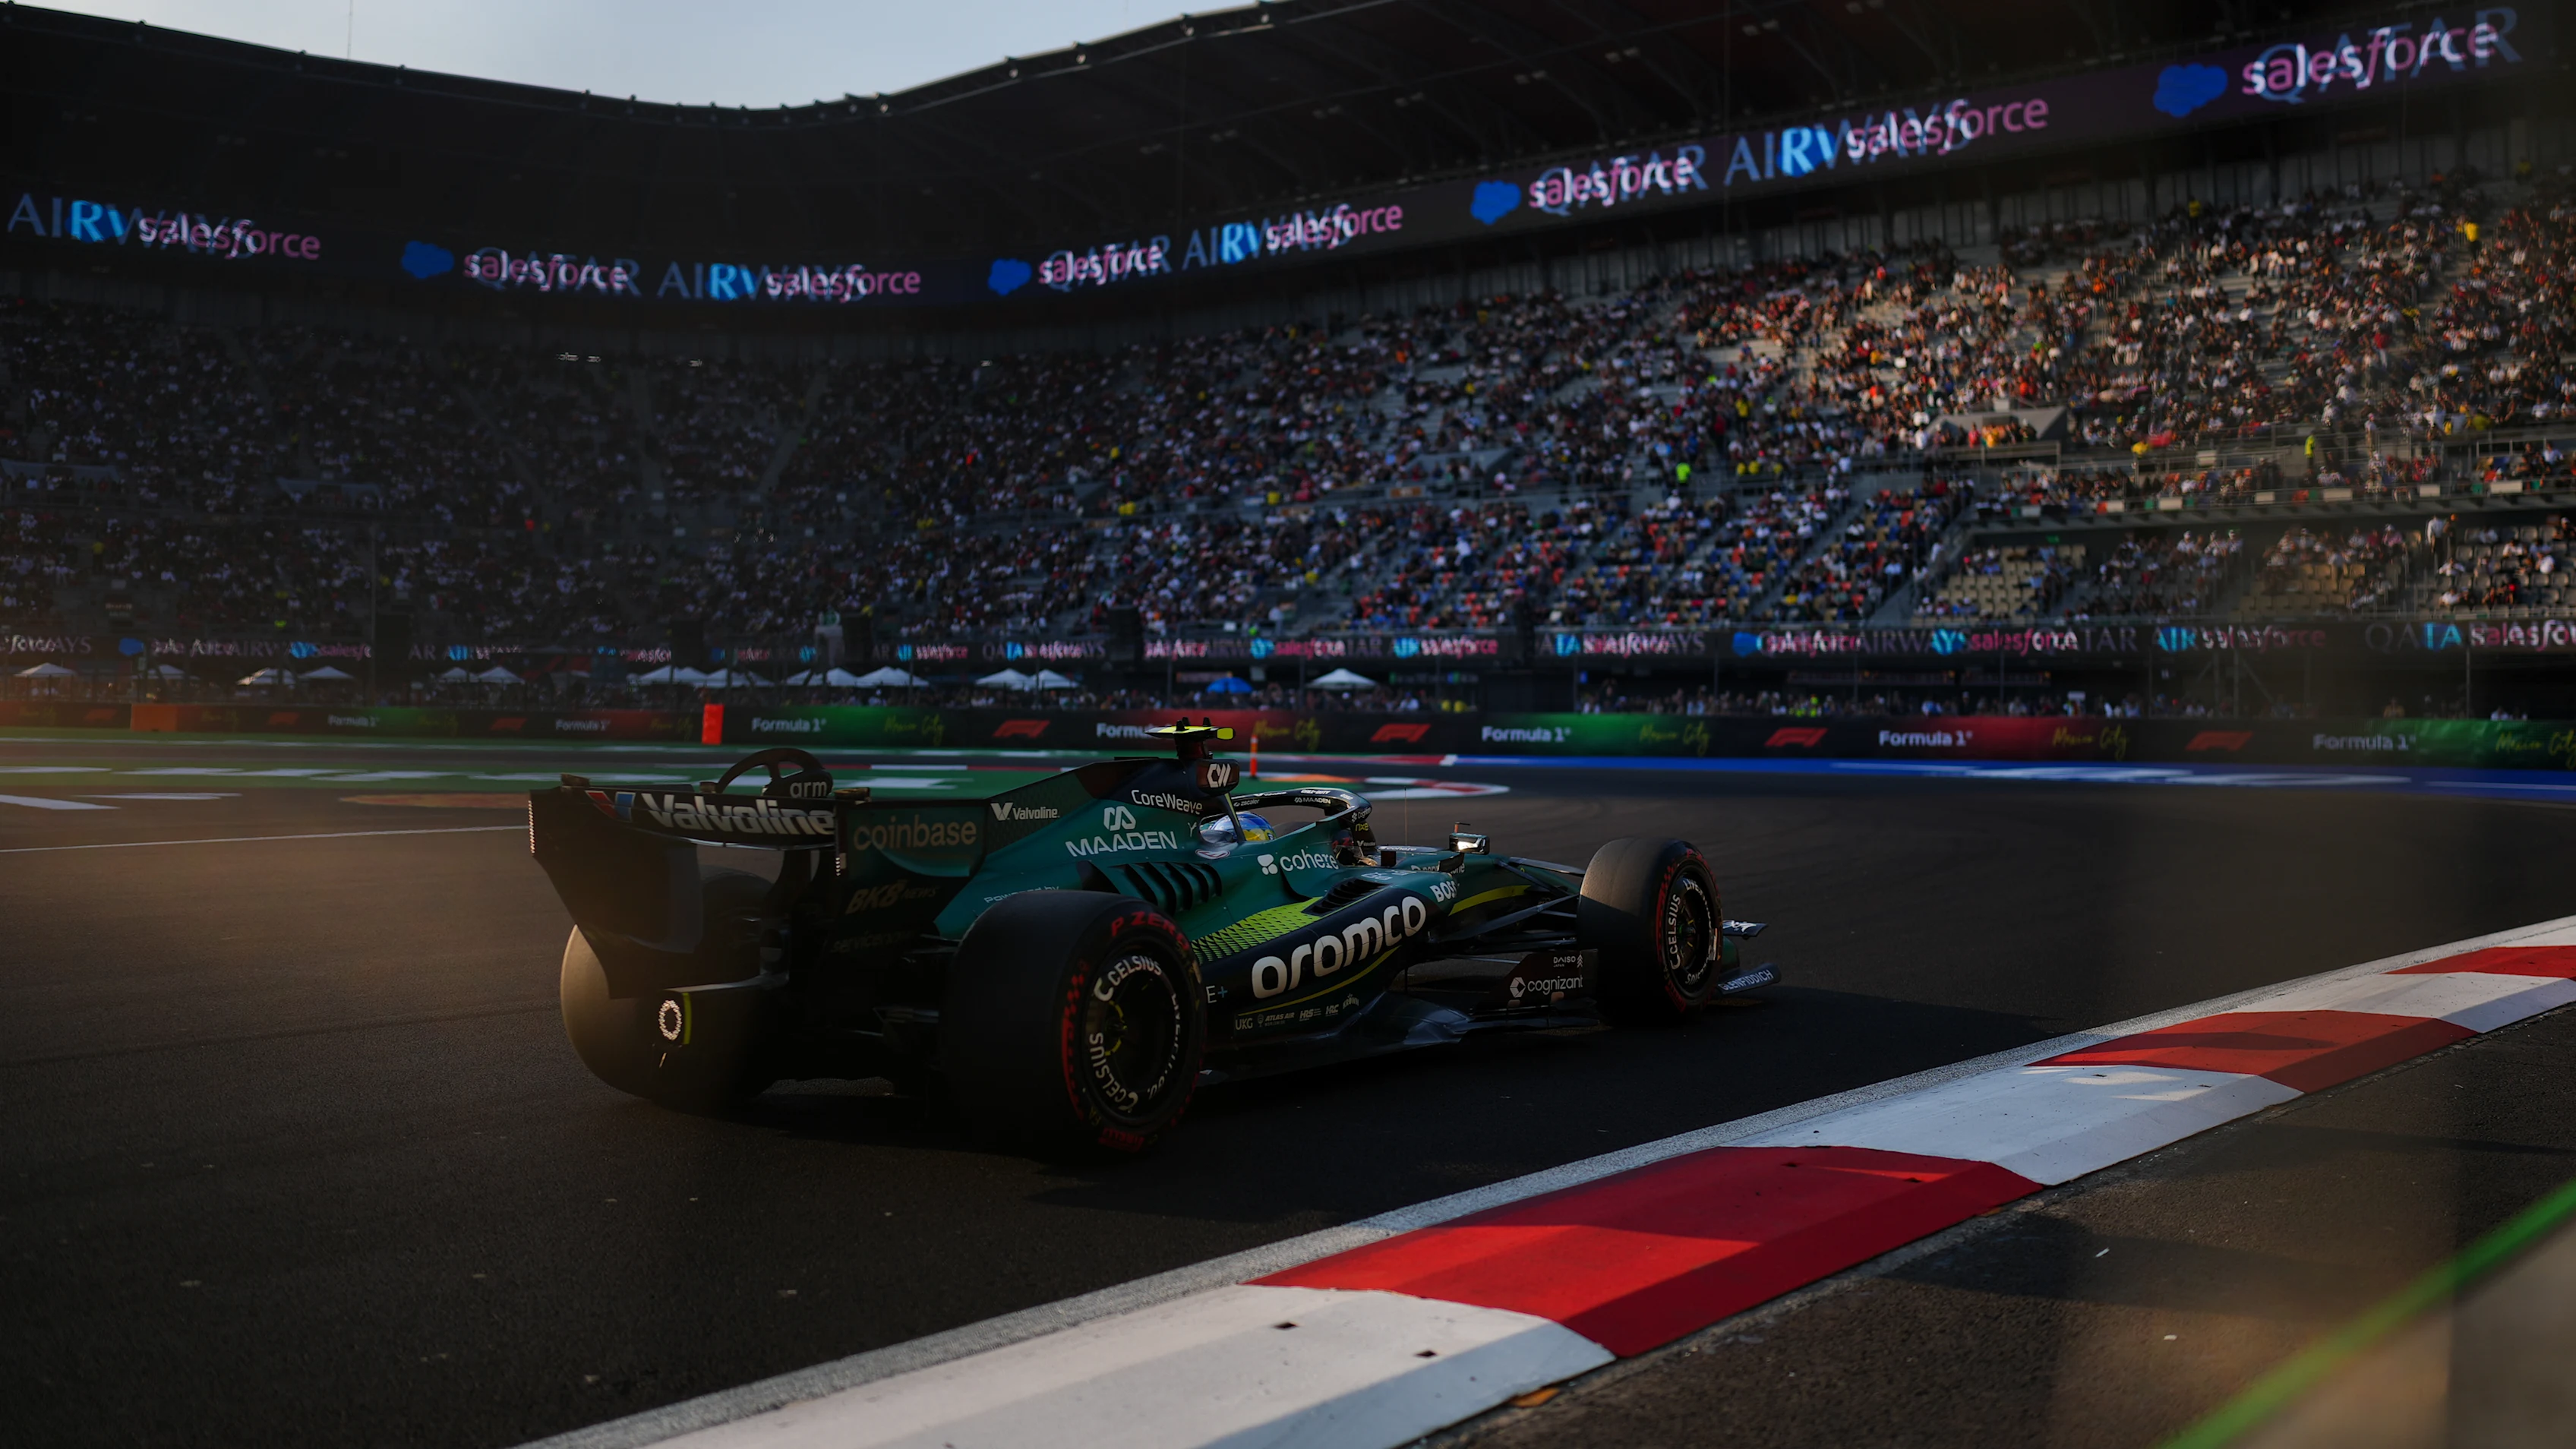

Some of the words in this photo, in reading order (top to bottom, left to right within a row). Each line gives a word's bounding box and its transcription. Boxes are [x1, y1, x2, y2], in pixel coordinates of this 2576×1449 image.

[2241, 23, 2499, 93] salesforce
[1846, 98, 2049, 160] salesforce
[1528, 156, 1694, 209] salesforce
[138, 216, 321, 259] salesforce
[1266, 204, 1403, 250] salesforce
[463, 252, 629, 292] salesforce
[1038, 243, 1163, 286] salesforce
[766, 264, 923, 304] salesforce
[751, 717, 810, 732] Formula
[1482, 726, 1552, 742] Formula
[1879, 731, 1953, 747] Formula
[2312, 734, 2393, 750] Formula
[790, 779, 828, 798] arm
[1131, 789, 1203, 815] CoreWeave
[642, 792, 837, 836] Valvoline
[1012, 806, 1059, 821] Valvoline
[853, 814, 977, 851] coinbase
[1065, 831, 1178, 857] MAADEN
[1279, 848, 1339, 871] cohere
[844, 880, 908, 915] BK8
[1668, 894, 1681, 955] CELSIUS
[1251, 896, 1427, 999] aramco
[1553, 956, 1576, 964] DAISO
[1107, 954, 1163, 987] CELSIUS
[1718, 969, 1774, 991] GLENFIDDICH
[1236, 1018, 1253, 1031] UKG
[1284, 1012, 1295, 1020] AIR
[1299, 1009, 1314, 1019] HRS
[1088, 1032, 1132, 1103] CELSIUS
